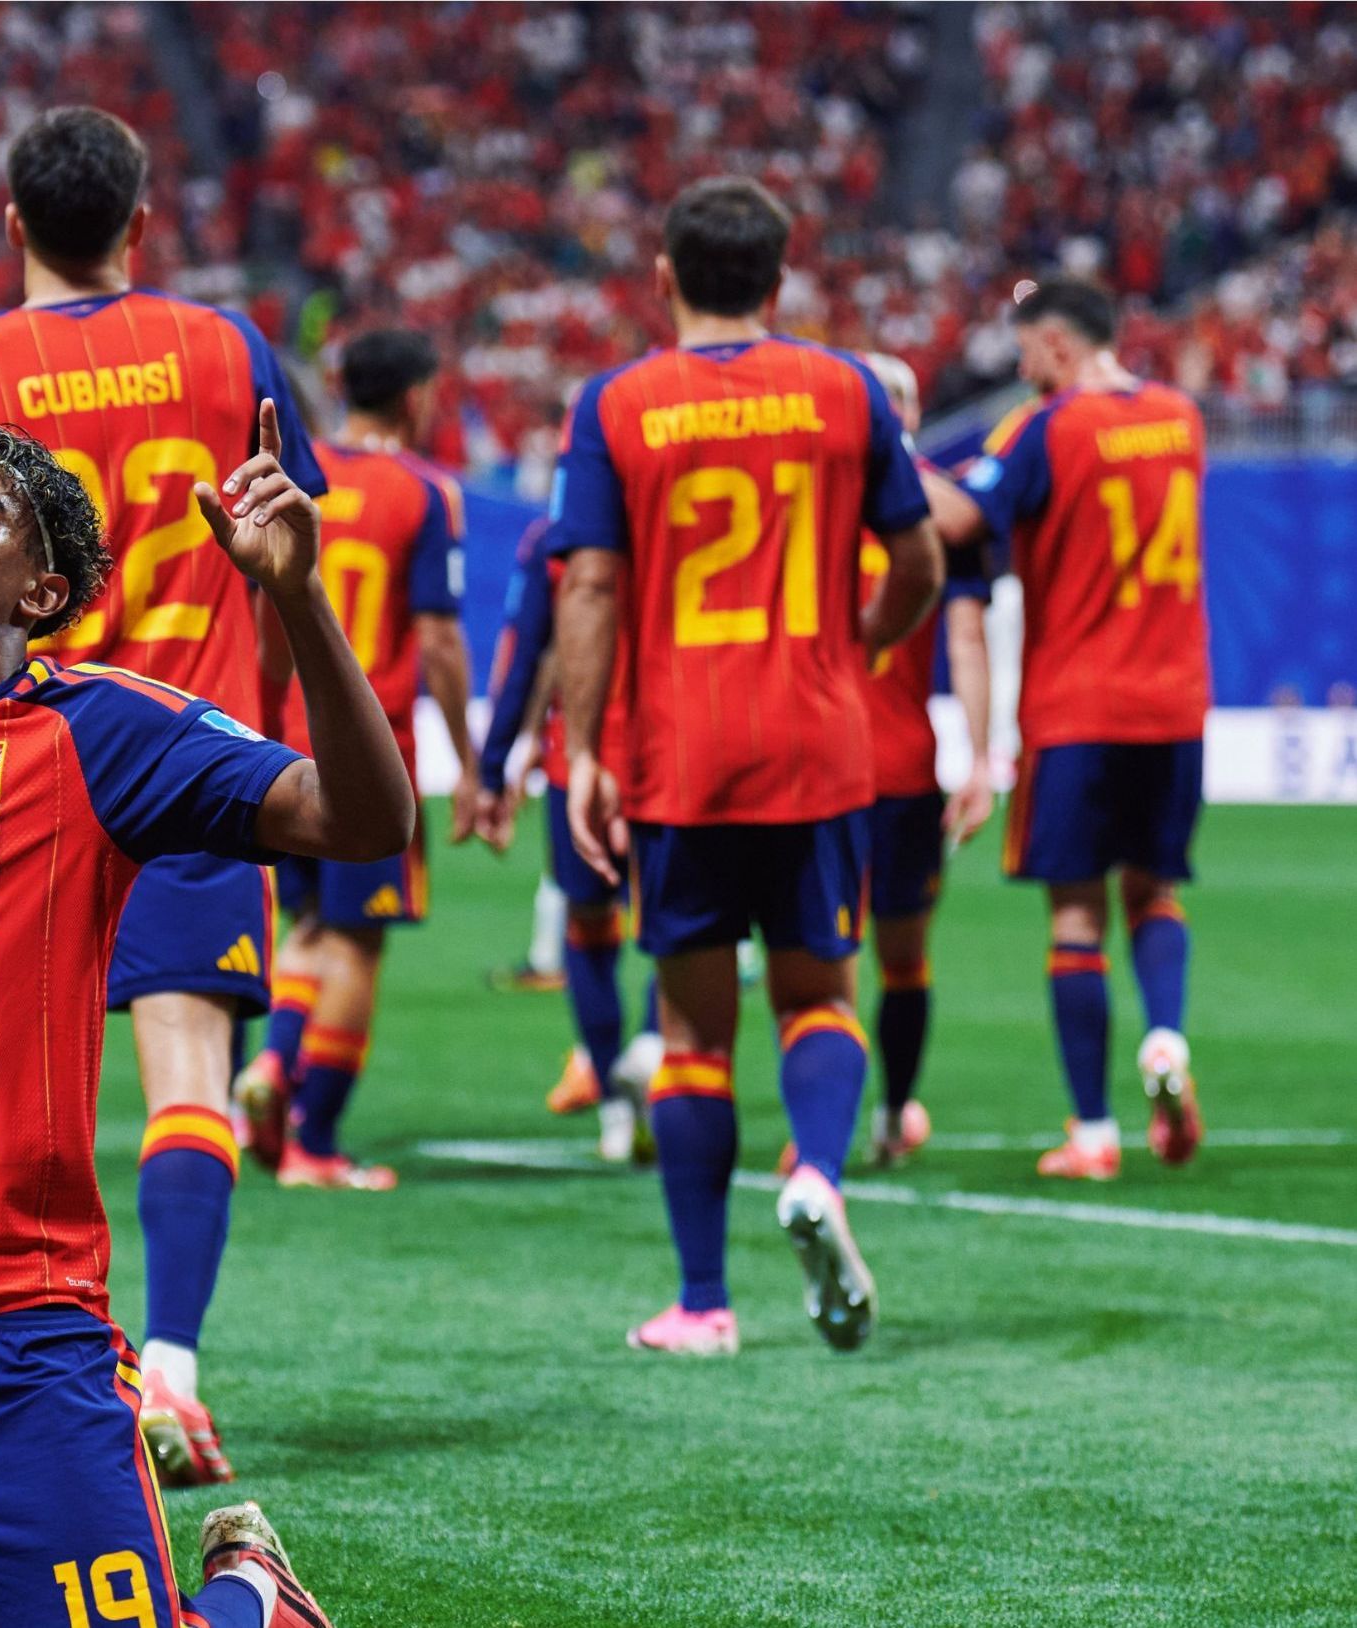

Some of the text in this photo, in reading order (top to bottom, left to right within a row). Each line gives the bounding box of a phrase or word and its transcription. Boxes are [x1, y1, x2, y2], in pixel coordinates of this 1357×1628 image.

[17, 351, 183, 419] CUBARSÍ
[642, 393, 826, 449] OYARZABAL
[668, 460, 819, 648] 21
[1099, 467, 1201, 609] 14
[53, 1550, 158, 1628] 19
